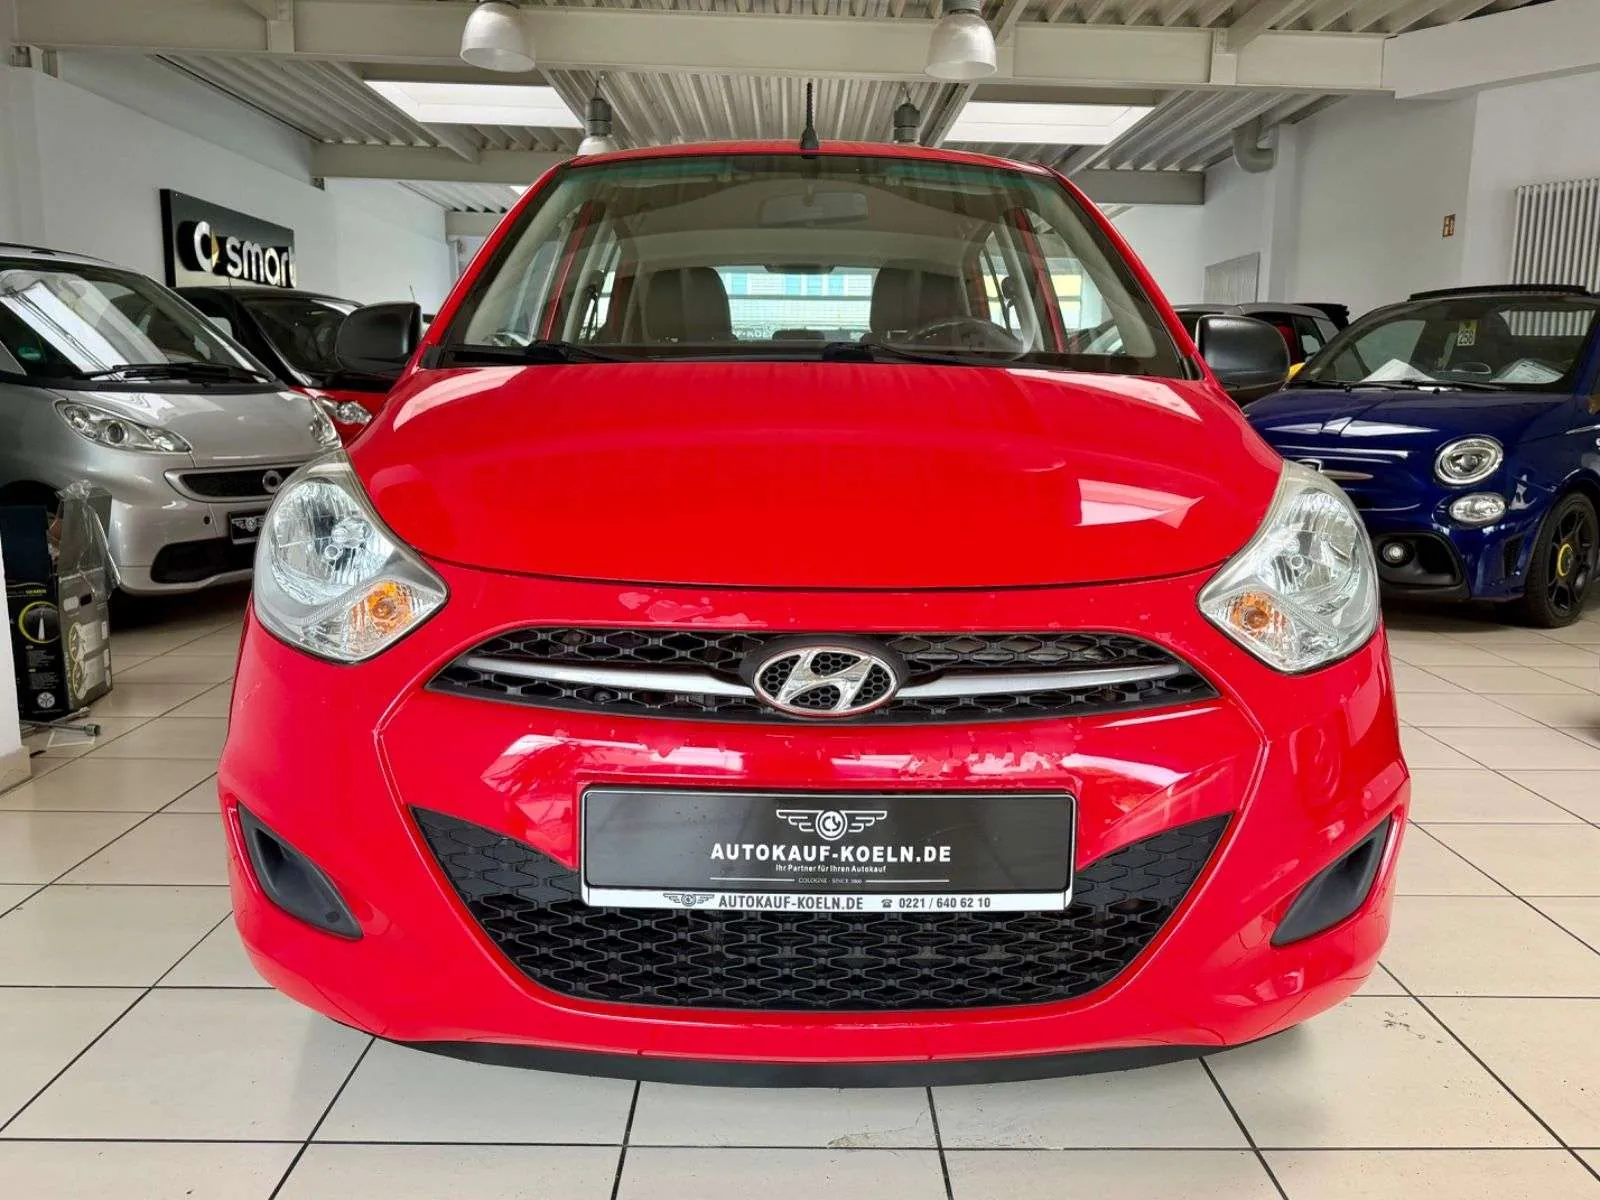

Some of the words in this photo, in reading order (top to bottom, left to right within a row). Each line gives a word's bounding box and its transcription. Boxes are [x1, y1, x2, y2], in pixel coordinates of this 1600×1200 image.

[710, 843, 951, 863] AUTOKAUF-KOELN.DE
[775, 864, 787, 872] Ihr
[788, 864, 817, 872] Partner
[818, 864, 829, 873] für
[830, 864, 850, 873] Ihren
[851, 865, 887, 873] Autokauf
[718, 895, 864, 911] AUTOKAUF-KOELN.DE
[898, 897, 926, 909] 0221
[936, 897, 958, 909] 640
[959, 897, 974, 909] 62
[976, 896, 991, 908] 10
